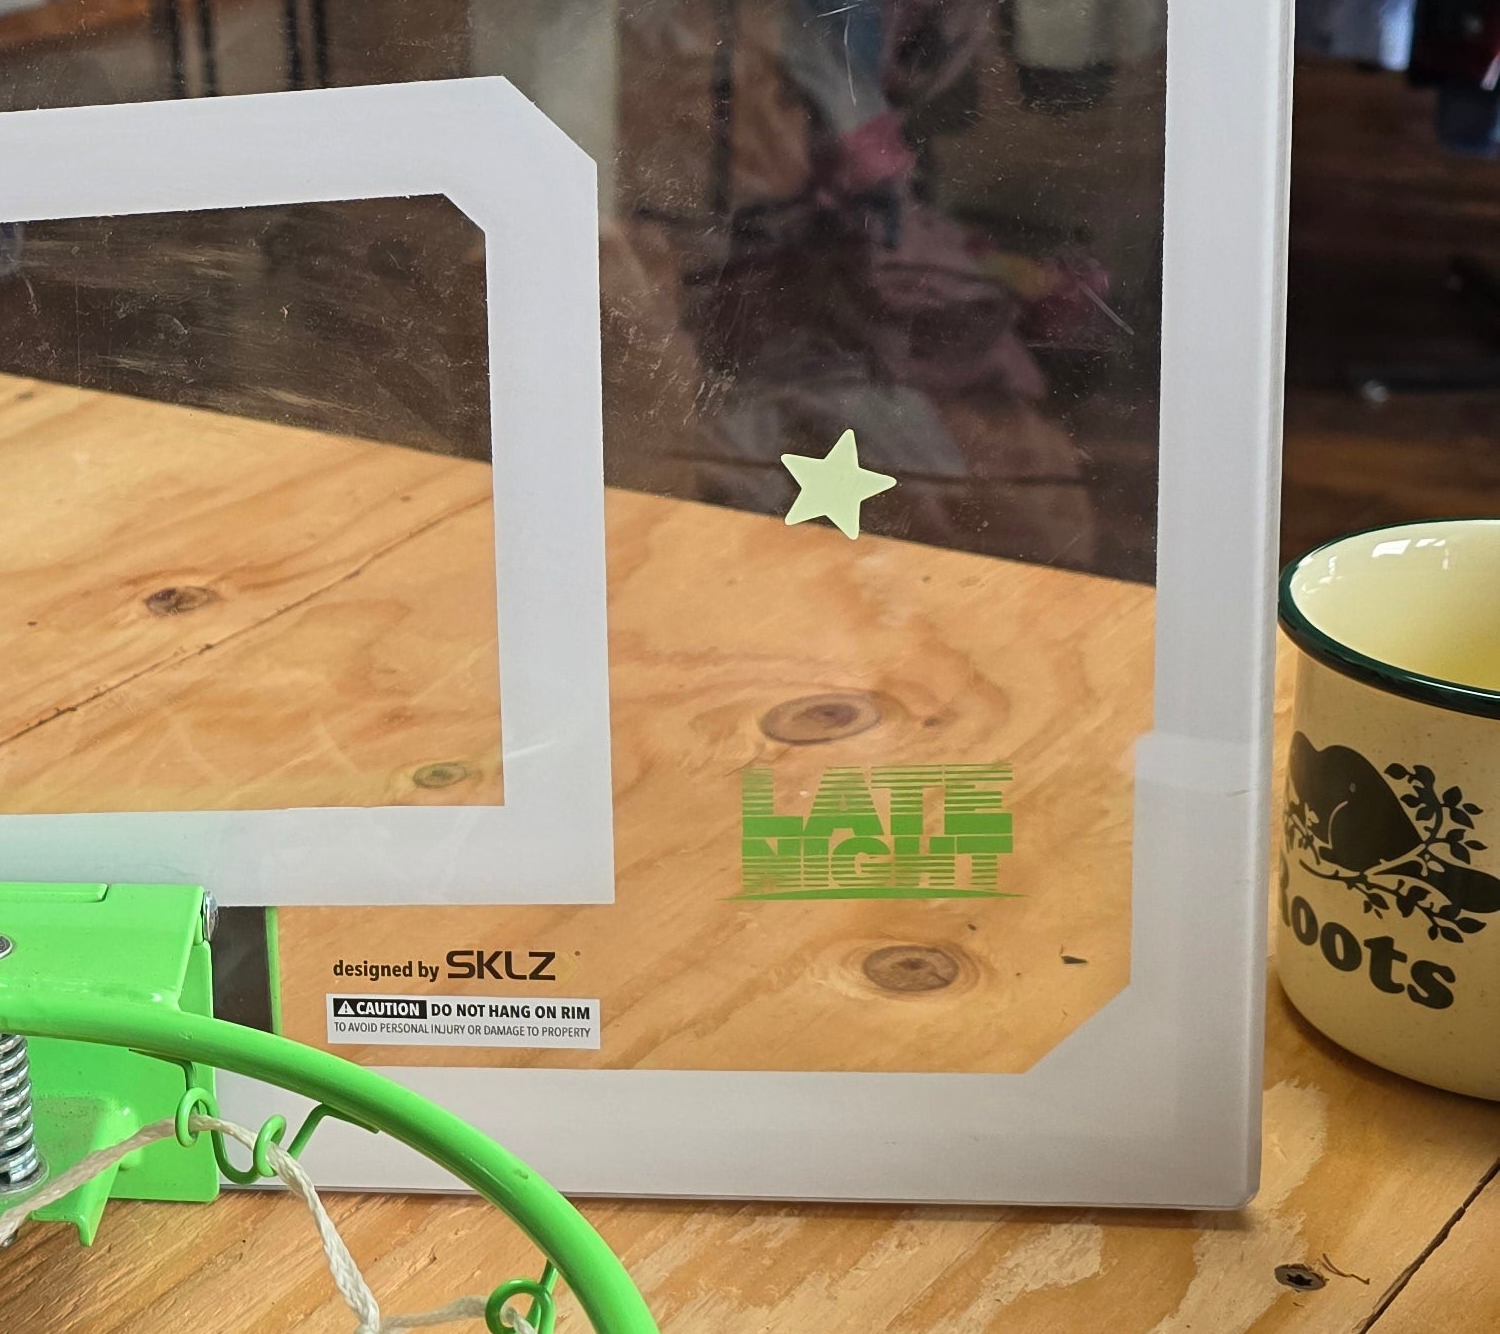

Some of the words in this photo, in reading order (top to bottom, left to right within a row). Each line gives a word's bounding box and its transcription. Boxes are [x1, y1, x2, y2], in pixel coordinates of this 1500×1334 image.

[741, 763, 1013, 837] LATE
[741, 835, 1013, 891] NIGHT
[332, 959, 413, 982] designed
[418, 960, 440, 982] by
[445, 950, 556, 981] SKLZ
[356, 1001, 420, 1017] CAUTION
[431, 1003, 453, 1017] DO
[456, 1003, 485, 1018] NOT
[489, 1004, 531, 1019] HANG
[534, 1005, 557, 1019] ON
[561, 1006, 591, 1020] RIM
[334, 1021, 347, 1033] TO
[348, 1022, 378, 1033] AVOID
[380, 1022, 429, 1034] PERSONAL
[431, 1023, 466, 1035] INJURY
[467, 1024, 481, 1036] OR
[484, 1025, 526, 1036] DAMAGE
[527, 1026, 539, 1037] TO
[541, 1027, 591, 1038] PROPERTY
